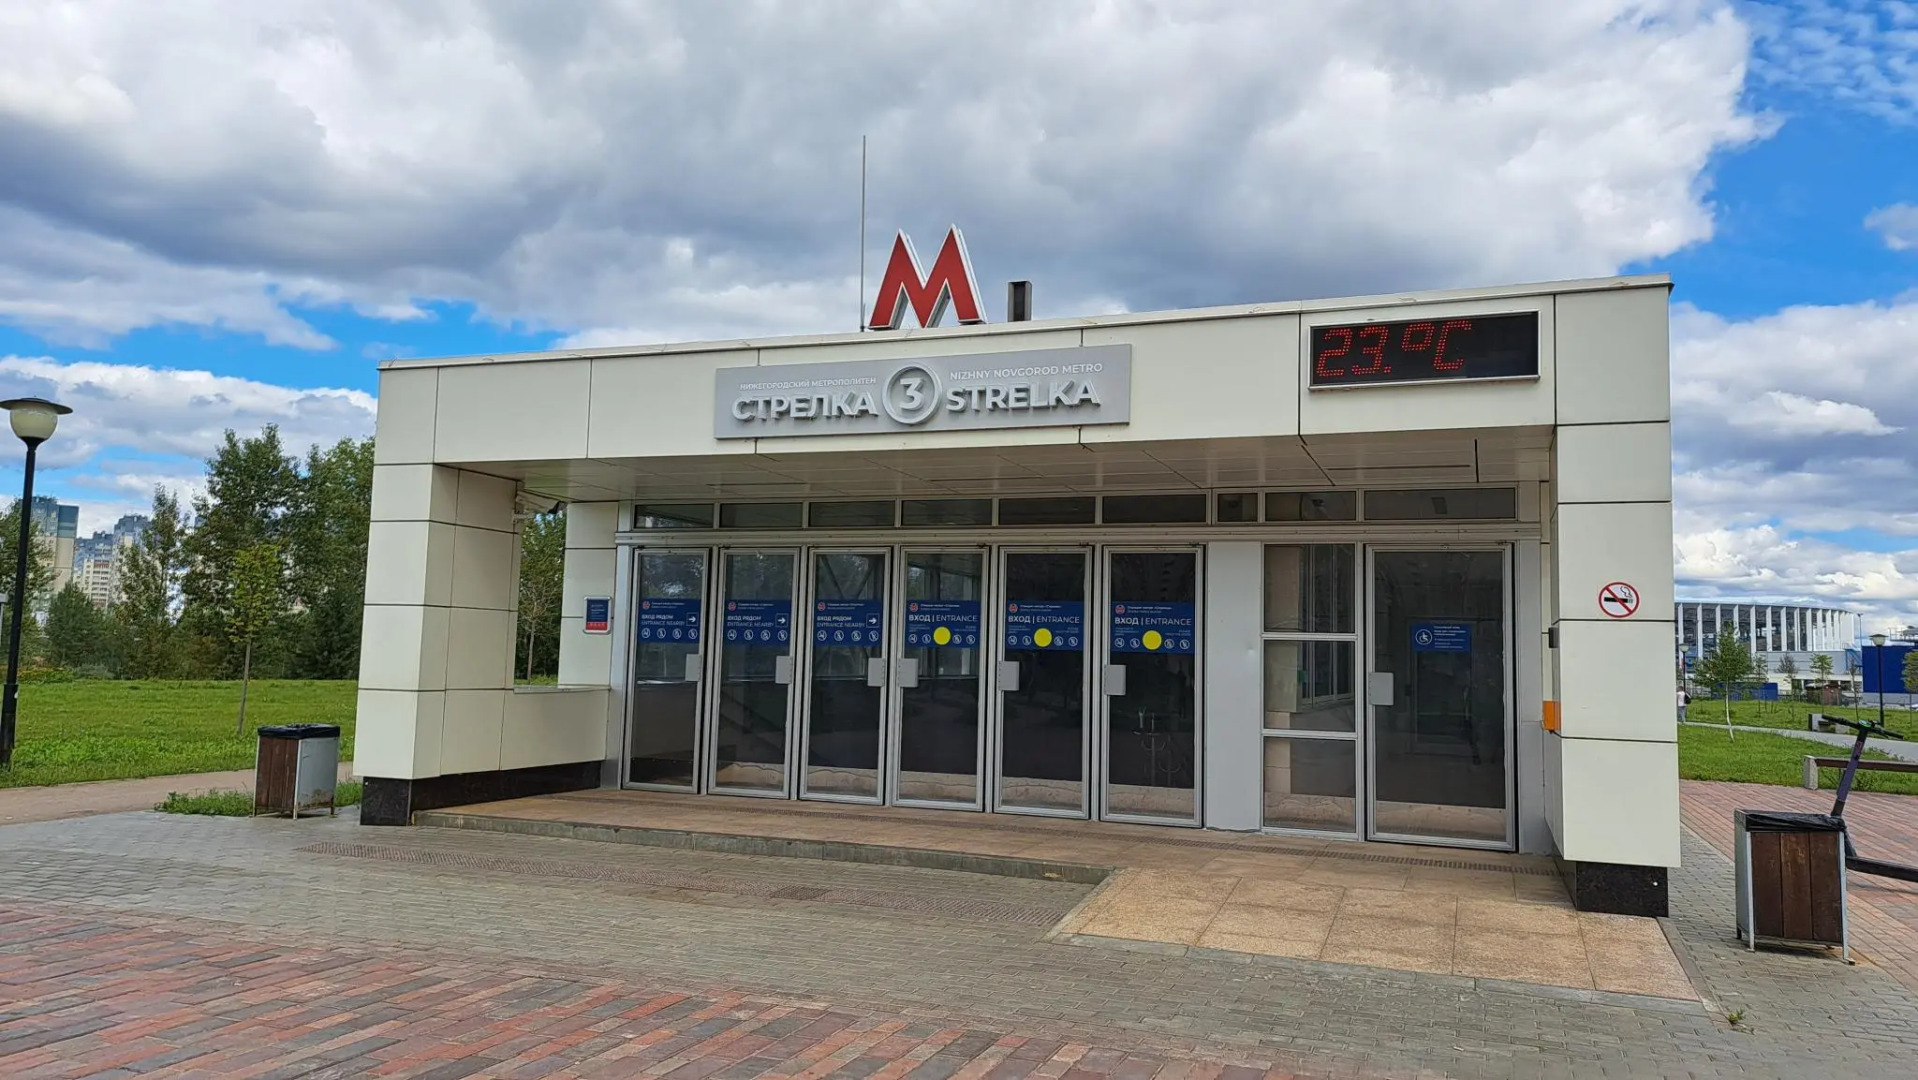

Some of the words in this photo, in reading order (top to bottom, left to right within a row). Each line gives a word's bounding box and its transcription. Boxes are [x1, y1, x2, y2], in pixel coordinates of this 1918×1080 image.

[950, 370, 994, 381] NIZHNY
[994, 366, 1059, 378] NOVGOROD
[1062, 363, 1103, 374] METRO
[739, 379, 810, 391] НИЖЕГОРОДСКИЙ
[811, 377, 877, 388] МЕТРОПОЛИТЕН
[899, 377, 925, 411] 3
[945, 380, 1102, 413] STRELKA
[731, 391, 880, 421] СТРЕЛКА
[908, 614, 931, 622] ВХОД
[936, 614, 978, 622] ENTRANCE
[1008, 615, 1031, 624] ВХОД
[1036, 615, 1080, 624] ENTRANCE
[1114, 617, 1139, 625] ВХОД
[1145, 617, 1192, 626] ENTRANCE
